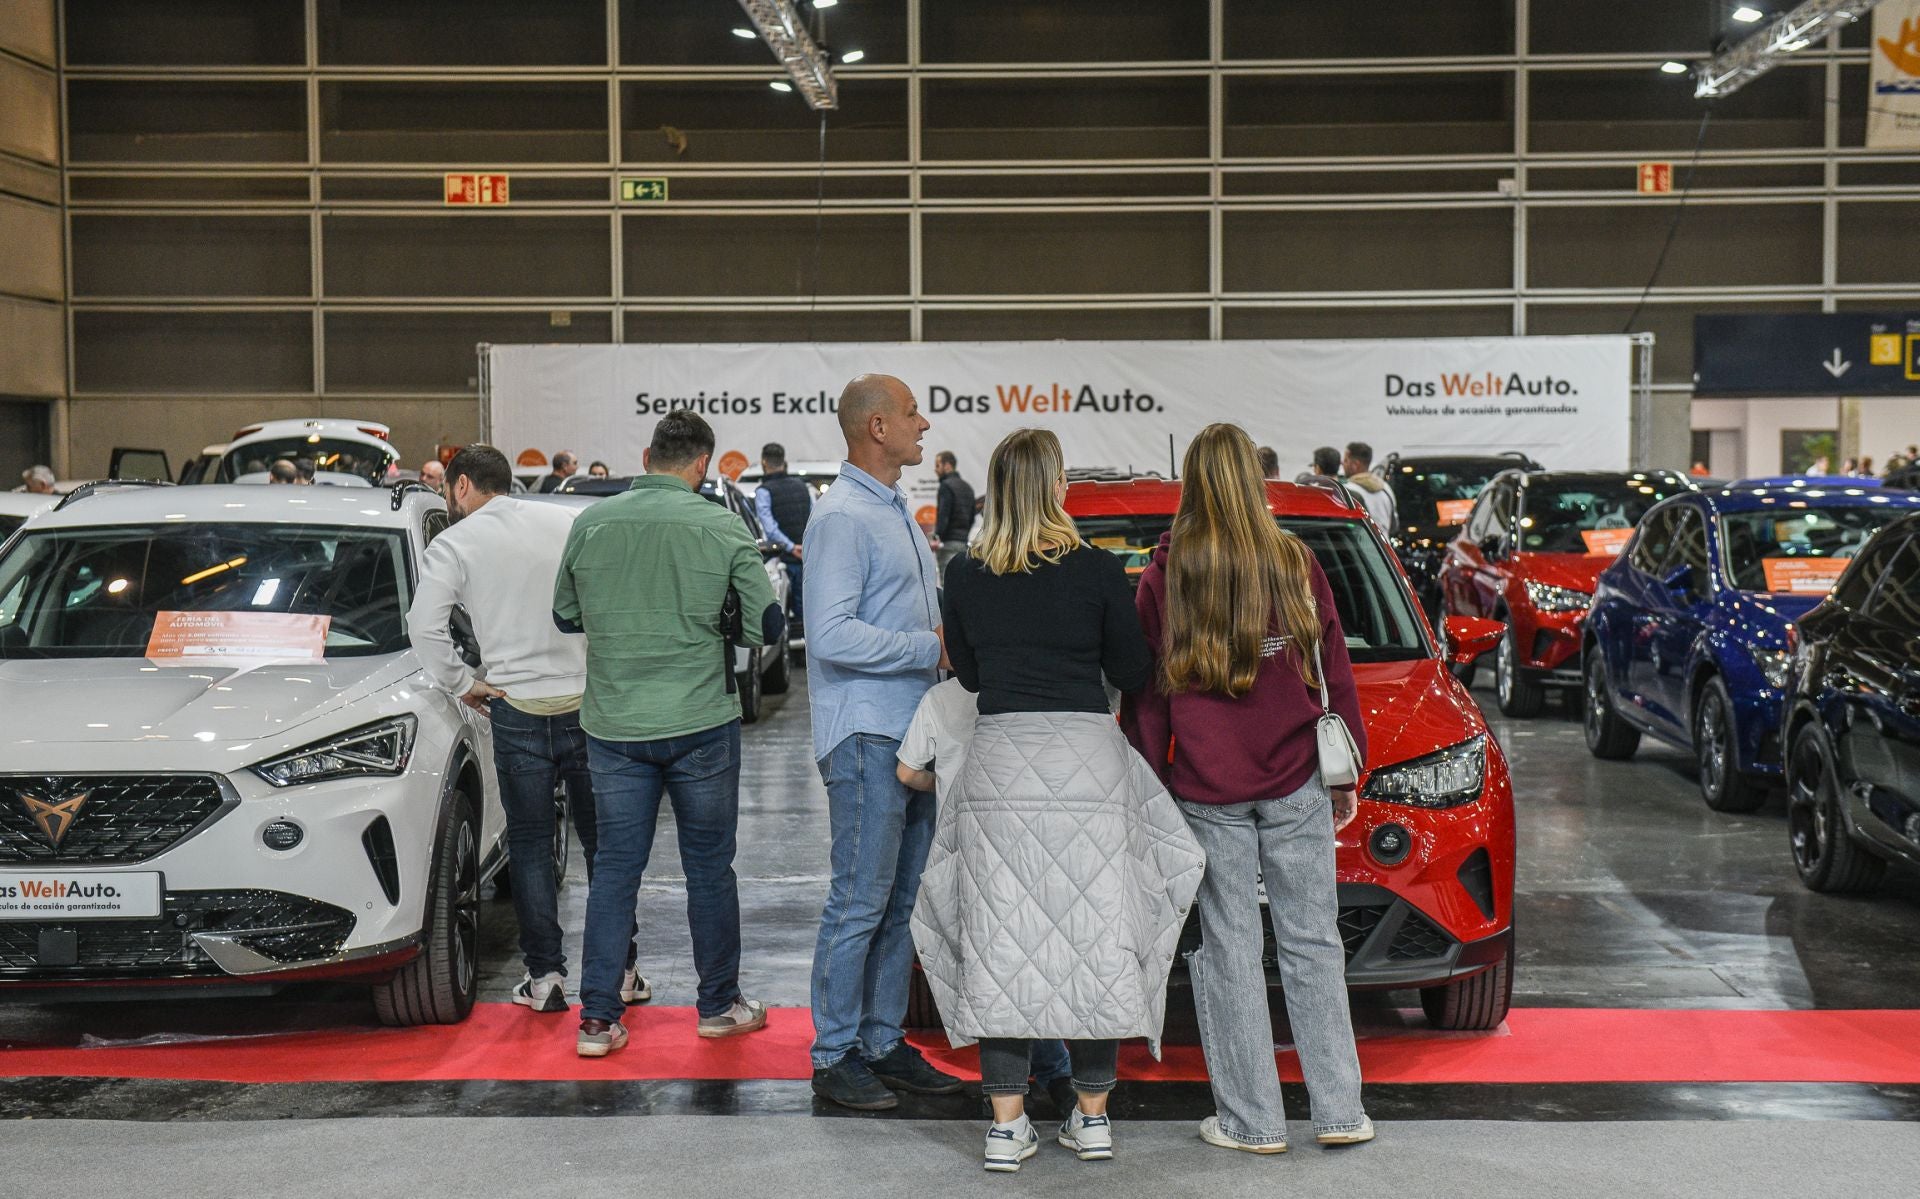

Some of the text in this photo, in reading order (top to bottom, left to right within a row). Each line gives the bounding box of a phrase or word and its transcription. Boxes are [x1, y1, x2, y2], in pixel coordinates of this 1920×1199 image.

[1879, 338, 1895, 361] 3
[1385, 372, 1578, 397] Das WeltAuto.
[637, 392, 762, 415] Servicios
[929, 384, 1164, 413] Das WeltAuto.
[1441, 405, 1456, 416] de
[1458, 404, 1502, 415] ocasión
[1505, 404, 1578, 418] garantizados
[20, 880, 121, 898] WeltAuto.
[21, 902, 31, 910] de
[34, 902, 65, 910] ocasión
[67, 902, 121, 912] garantizados
